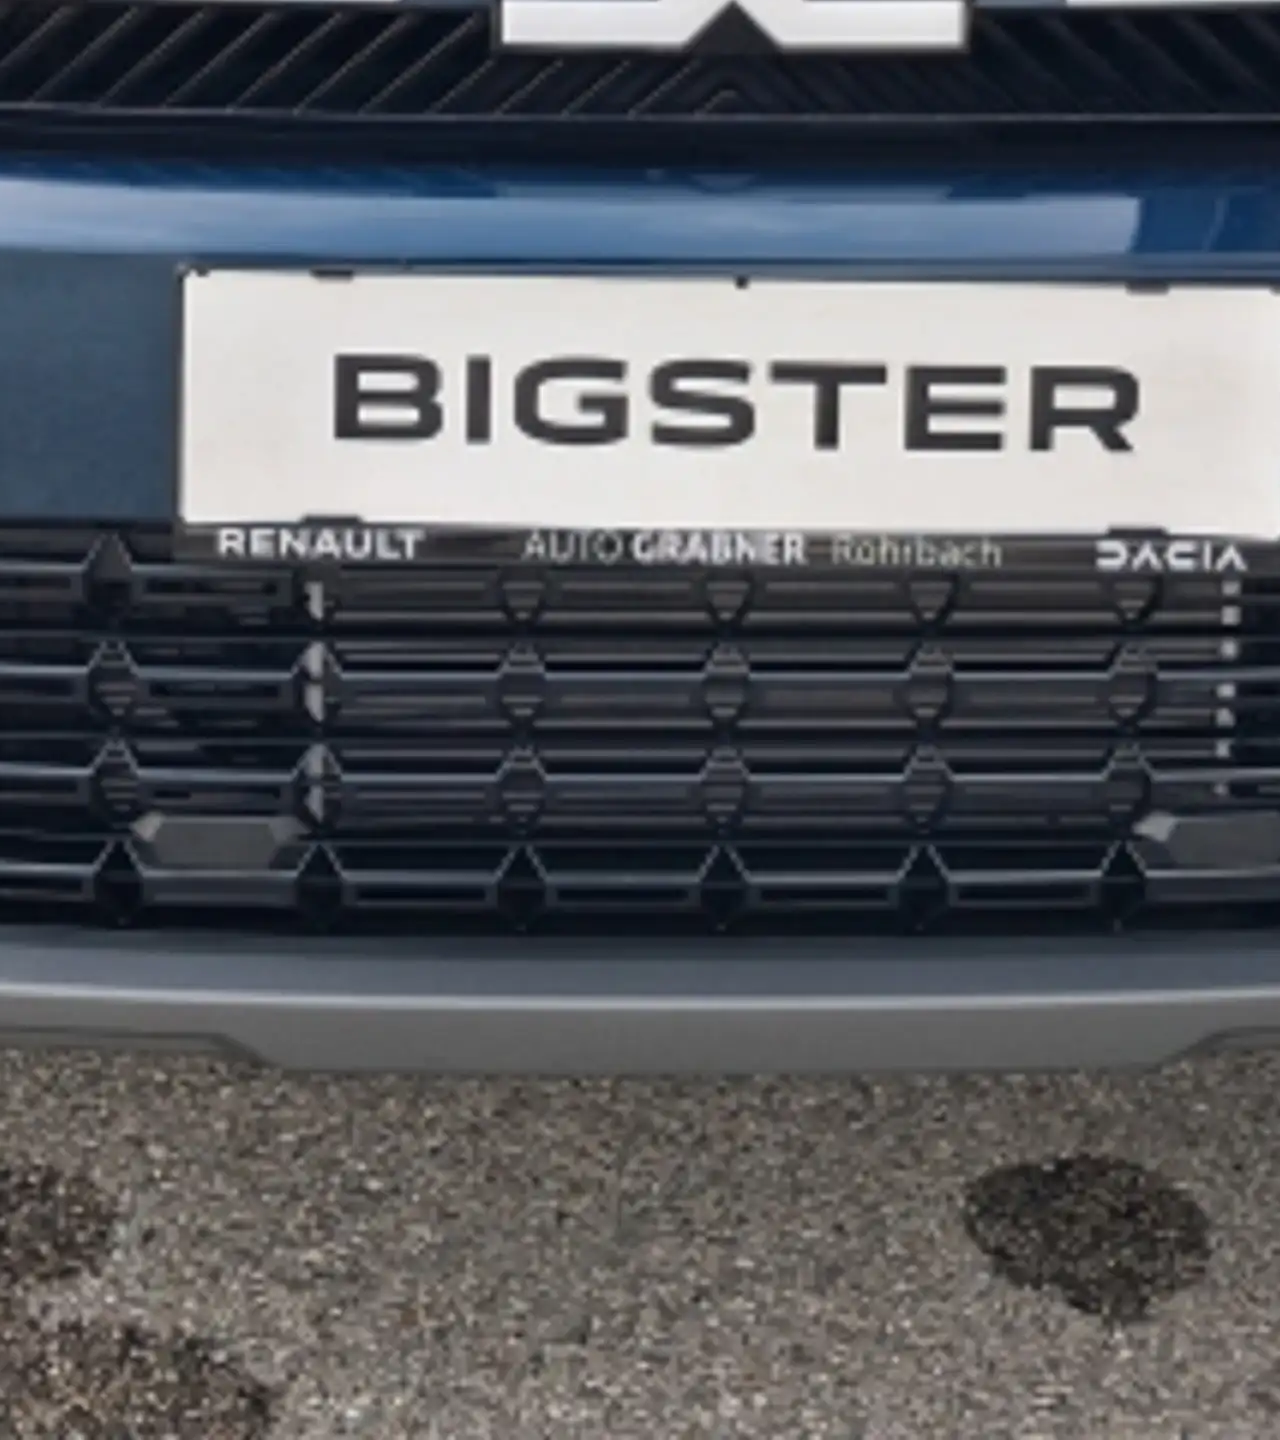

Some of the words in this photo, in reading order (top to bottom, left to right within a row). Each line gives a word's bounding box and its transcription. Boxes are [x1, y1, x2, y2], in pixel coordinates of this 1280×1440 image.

[333, 353, 1141, 453] BIGSTER
[216, 527, 425, 561] RENAULT
[521, 529, 623, 566] AUTO
[631, 530, 809, 566] GRABNER
[1095, 539, 1249, 573] DACIA
